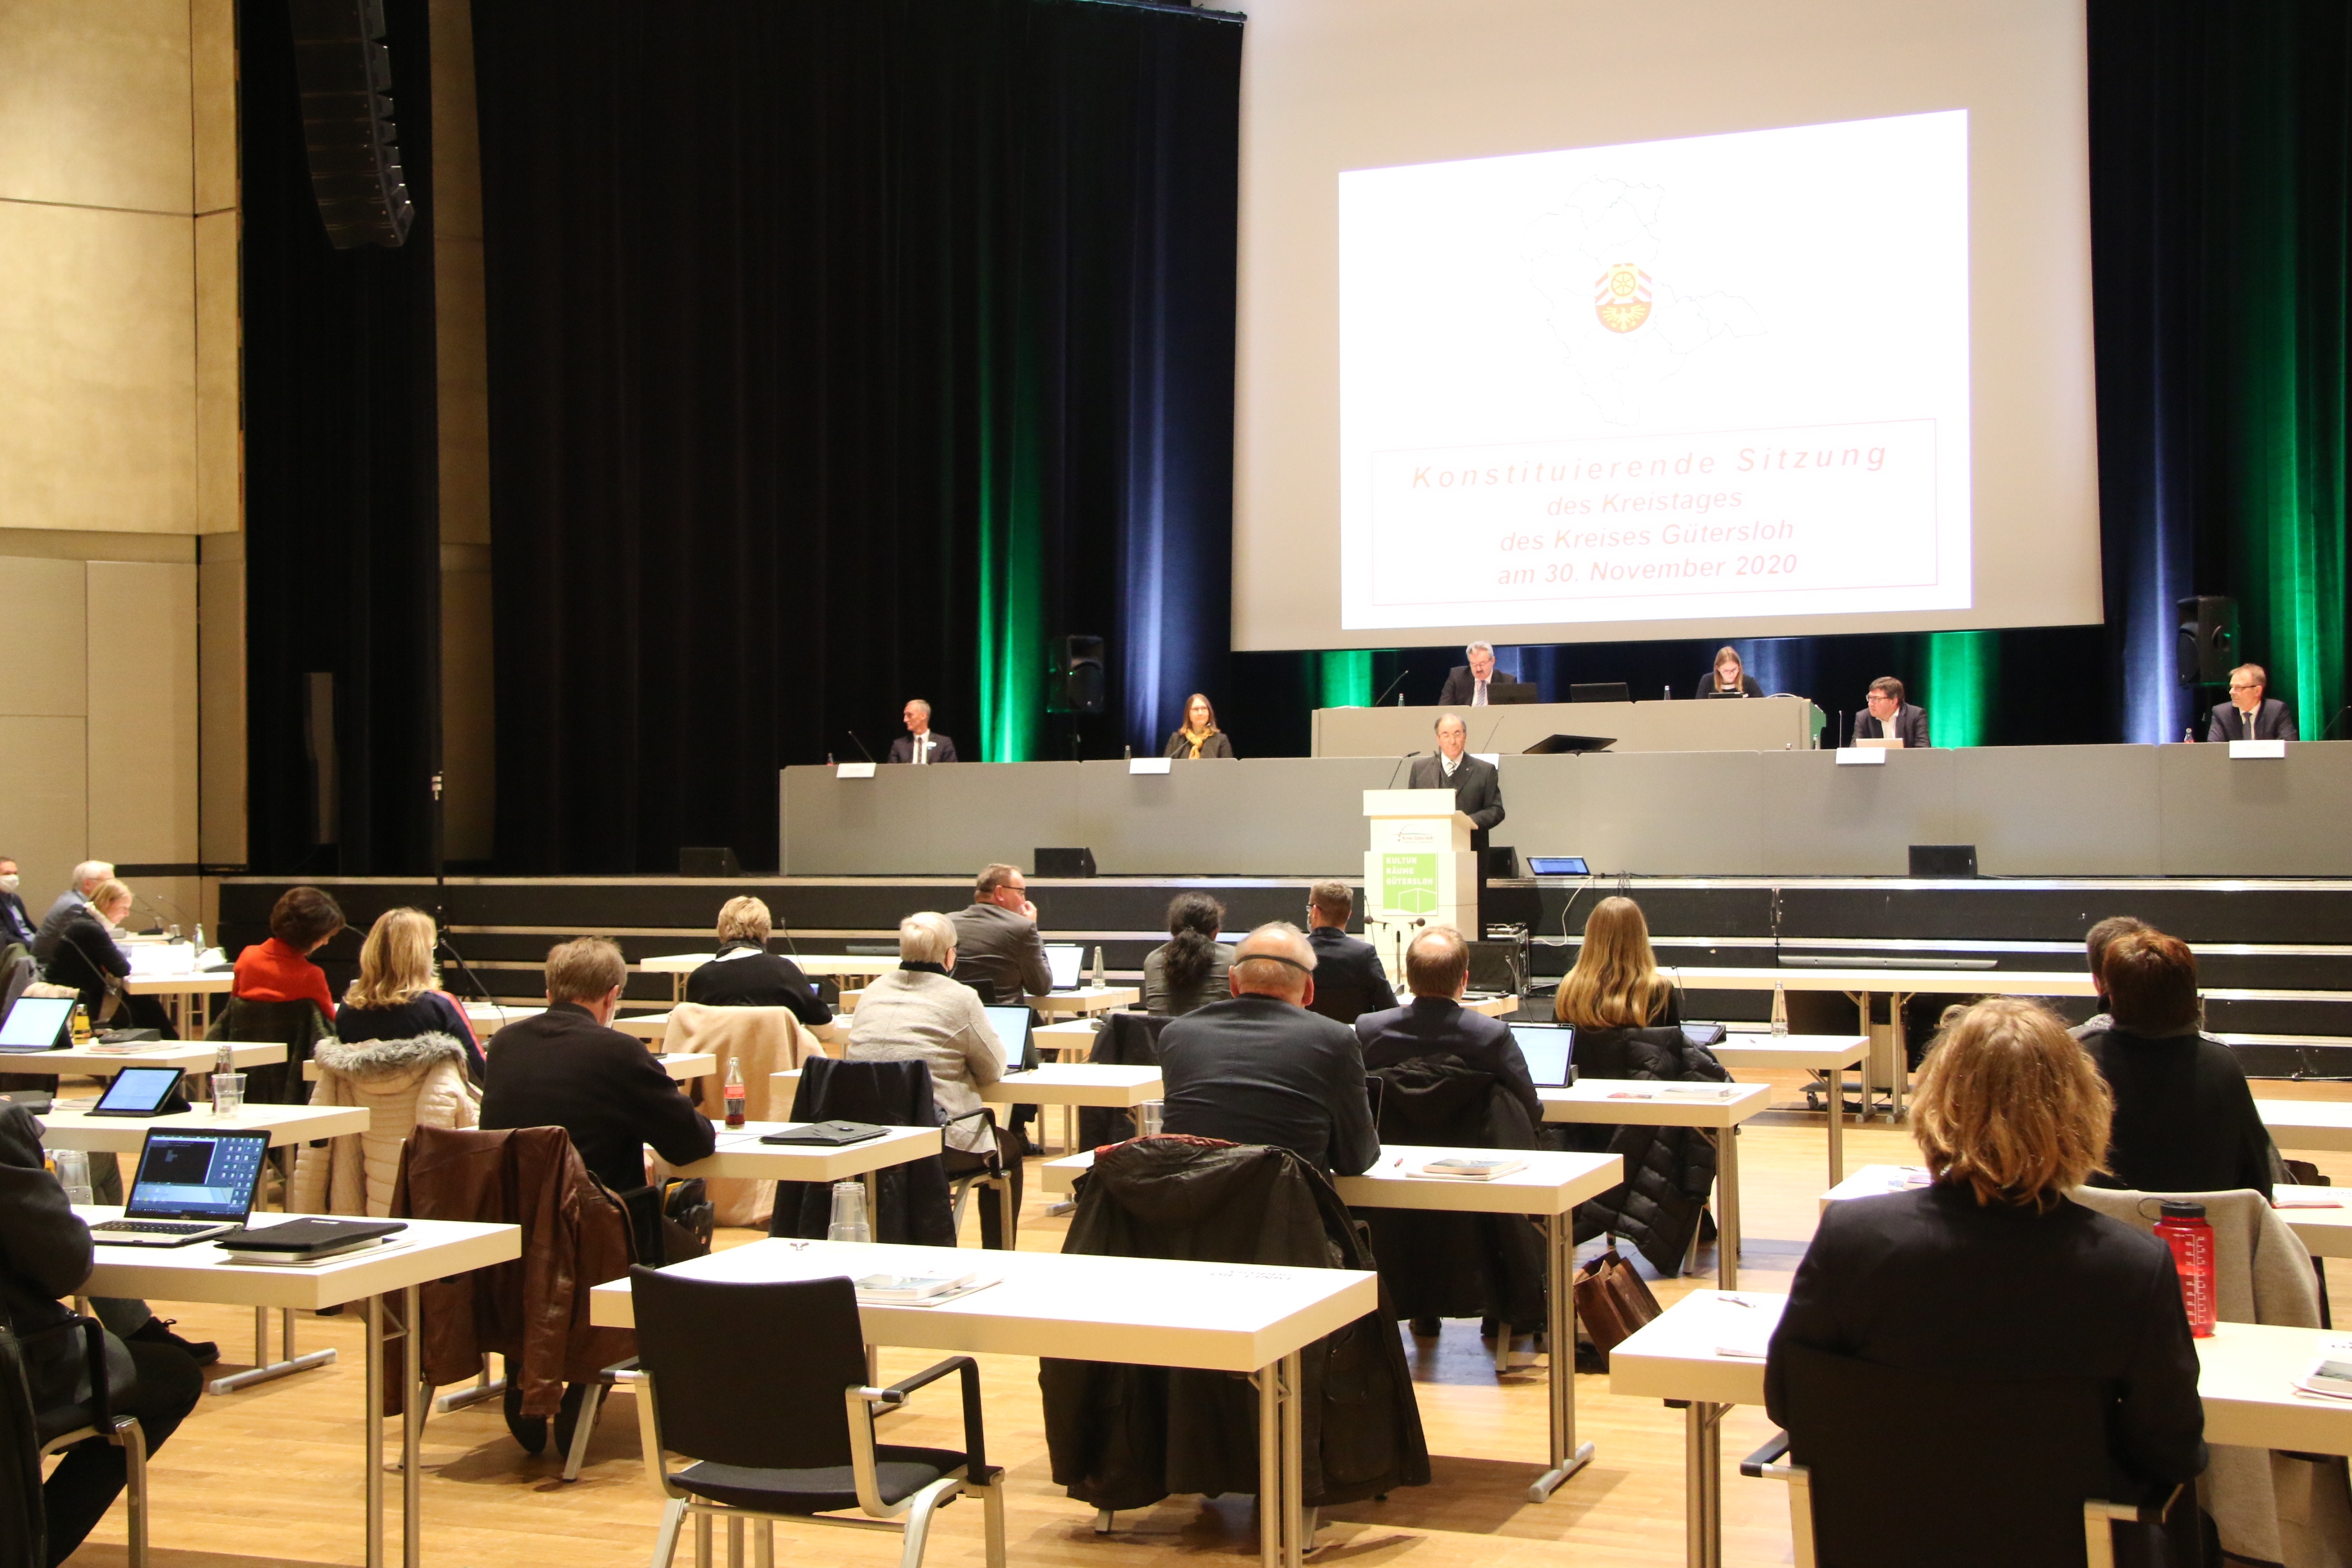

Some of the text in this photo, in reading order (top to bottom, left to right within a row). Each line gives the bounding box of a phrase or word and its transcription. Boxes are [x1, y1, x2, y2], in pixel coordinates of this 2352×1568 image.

[1412, 447, 1886, 489] Konstituierende Sitzung
[1547, 491, 1742, 516] des Kreistages
[1500, 519, 1794, 551] des Kreises Gütersloh
[1498, 553, 1798, 585] am 30. November 2020
[1386, 866, 1415, 874] RÄUME
[1386, 876, 1433, 885] GÜTERSLOH
